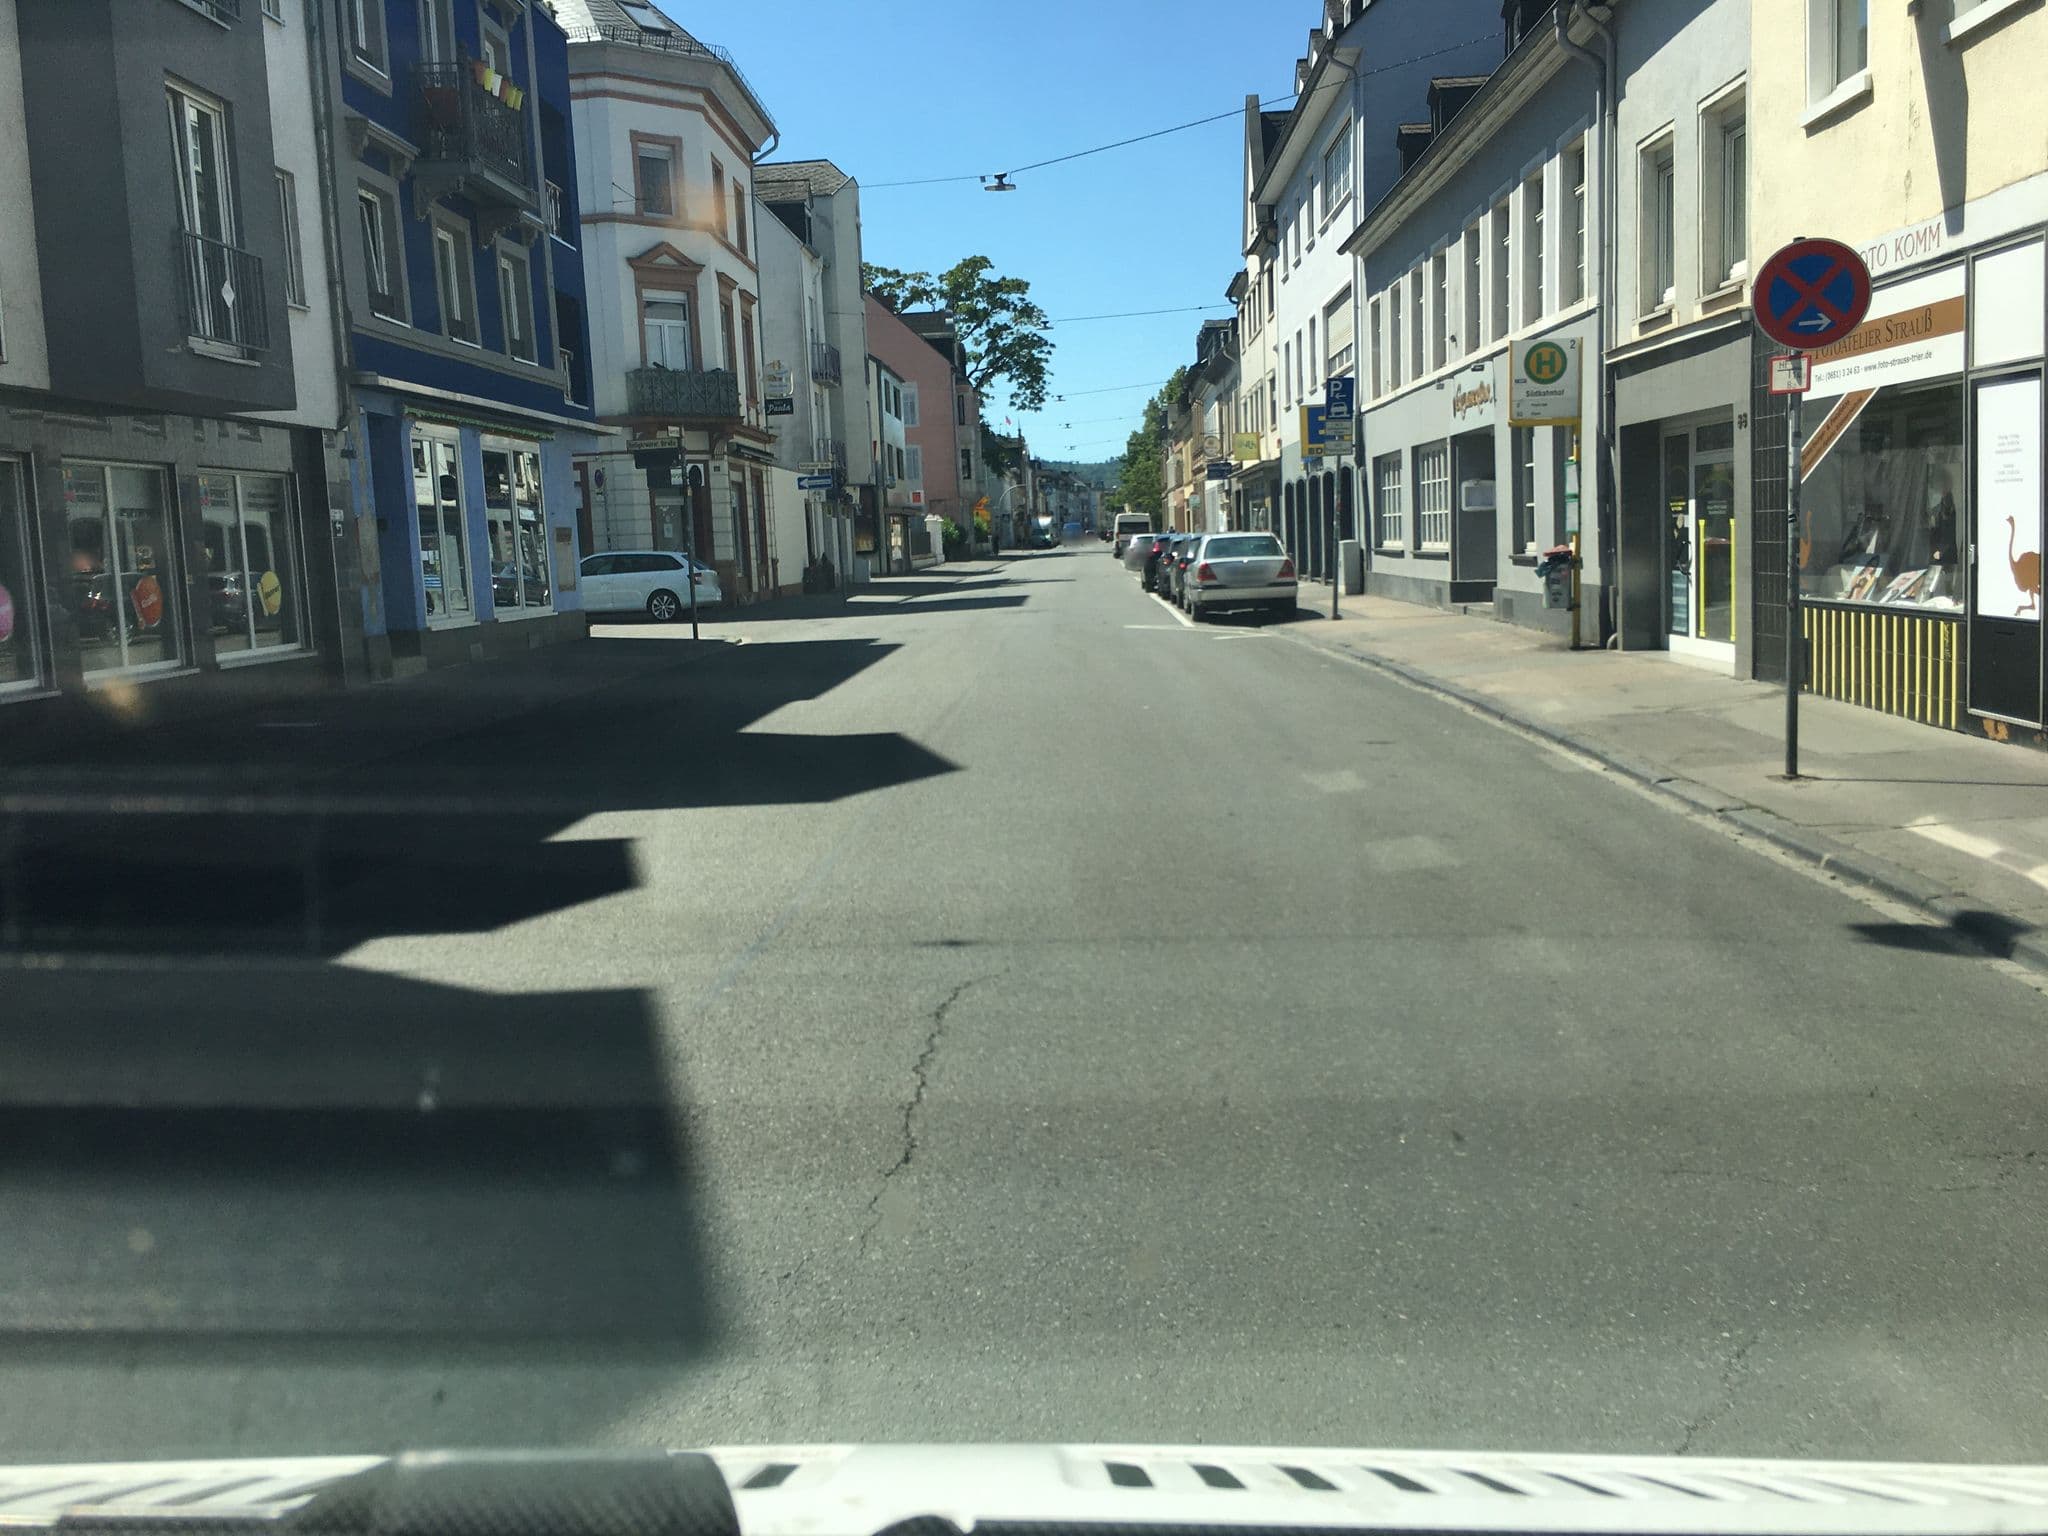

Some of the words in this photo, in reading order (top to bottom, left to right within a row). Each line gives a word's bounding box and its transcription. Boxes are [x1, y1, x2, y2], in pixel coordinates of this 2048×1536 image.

[1860, 243, 1888, 270] OTO
[1894, 222, 1941, 262] KOMM
[1569, 339, 1577, 350] 2
[1535, 351, 1557, 375] H
[1329, 380, 1343, 398] P
[1525, 389, 1565, 398] Südbahnhof
[1737, 412, 1748, 430] 33
